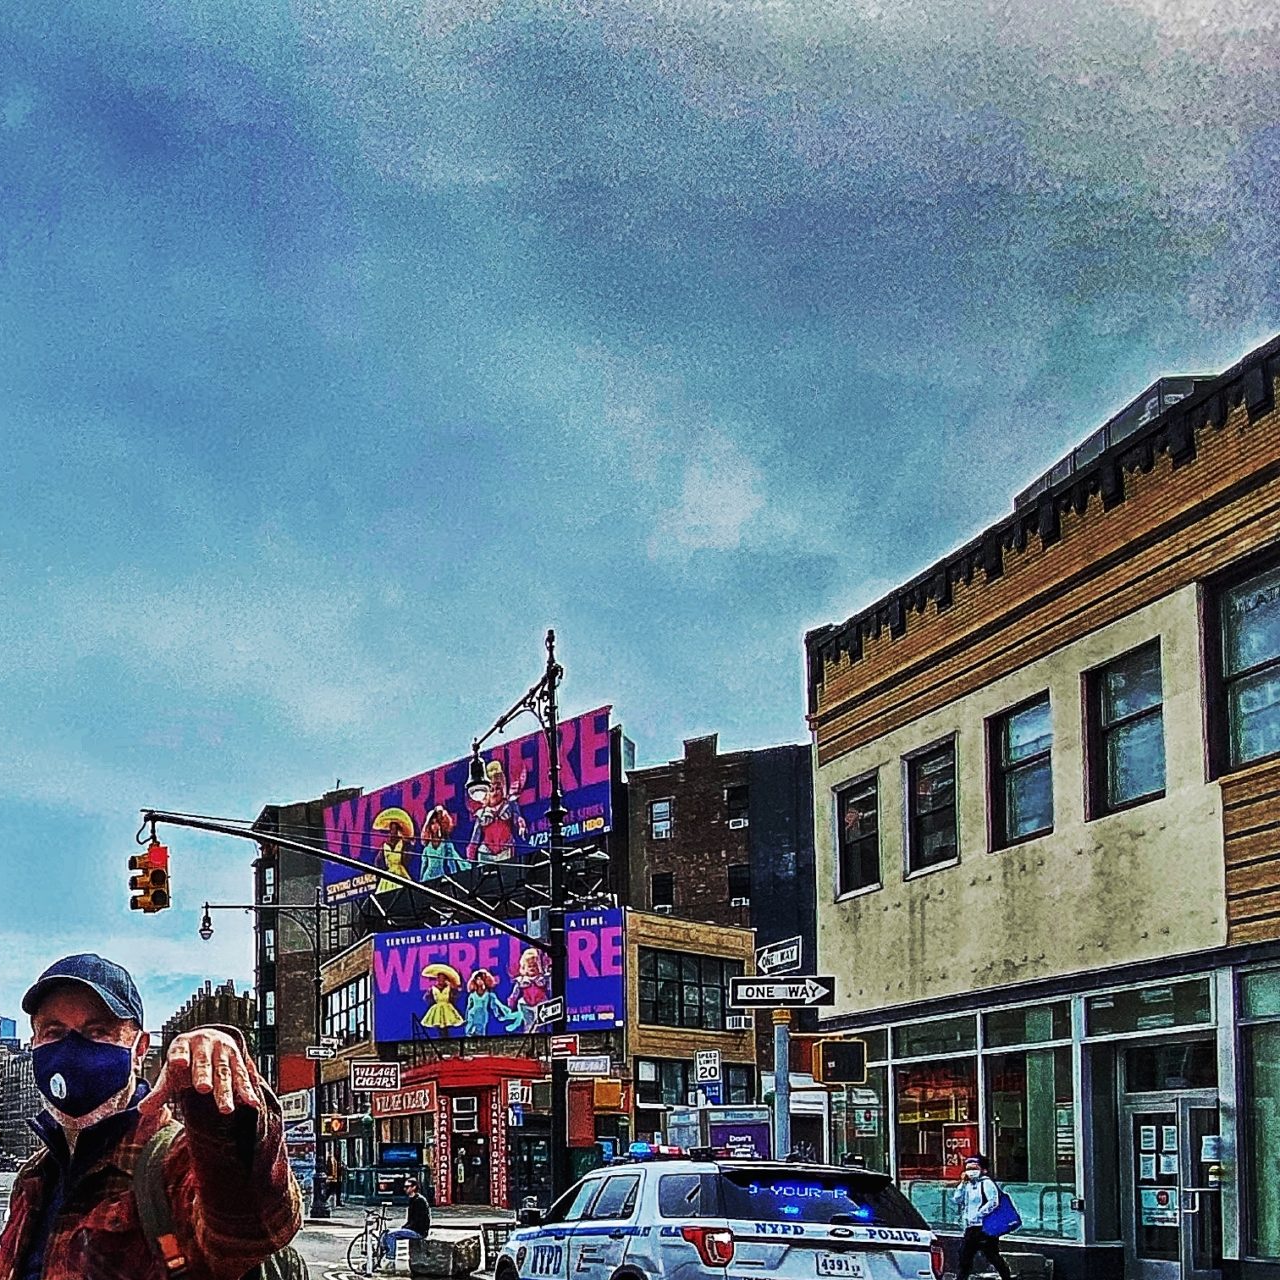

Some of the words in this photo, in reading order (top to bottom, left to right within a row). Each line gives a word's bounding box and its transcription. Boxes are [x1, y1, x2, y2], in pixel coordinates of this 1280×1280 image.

[386, 935, 422, 947] SERVING
[762, 954, 774, 967] ONE
[780, 948, 795, 961] WAY
[374, 938, 499, 995] WE'RE
[745, 986, 774, 998] ONE
[788, 986, 819, 998] WAY
[354, 1067, 397, 1077] VILLAGE
[700, 1066, 718, 1078] 20
[354, 1077, 397, 1088] CIGARS
[946, 1138, 970, 1150] open
[770, 1185, 822, 1198] YOUR
[755, 1223, 804, 1235] NYPD
[866, 1229, 921, 1243] POLICE
[531, 1244, 563, 1275] NYPD
[821, 1258, 850, 1271] 4391
